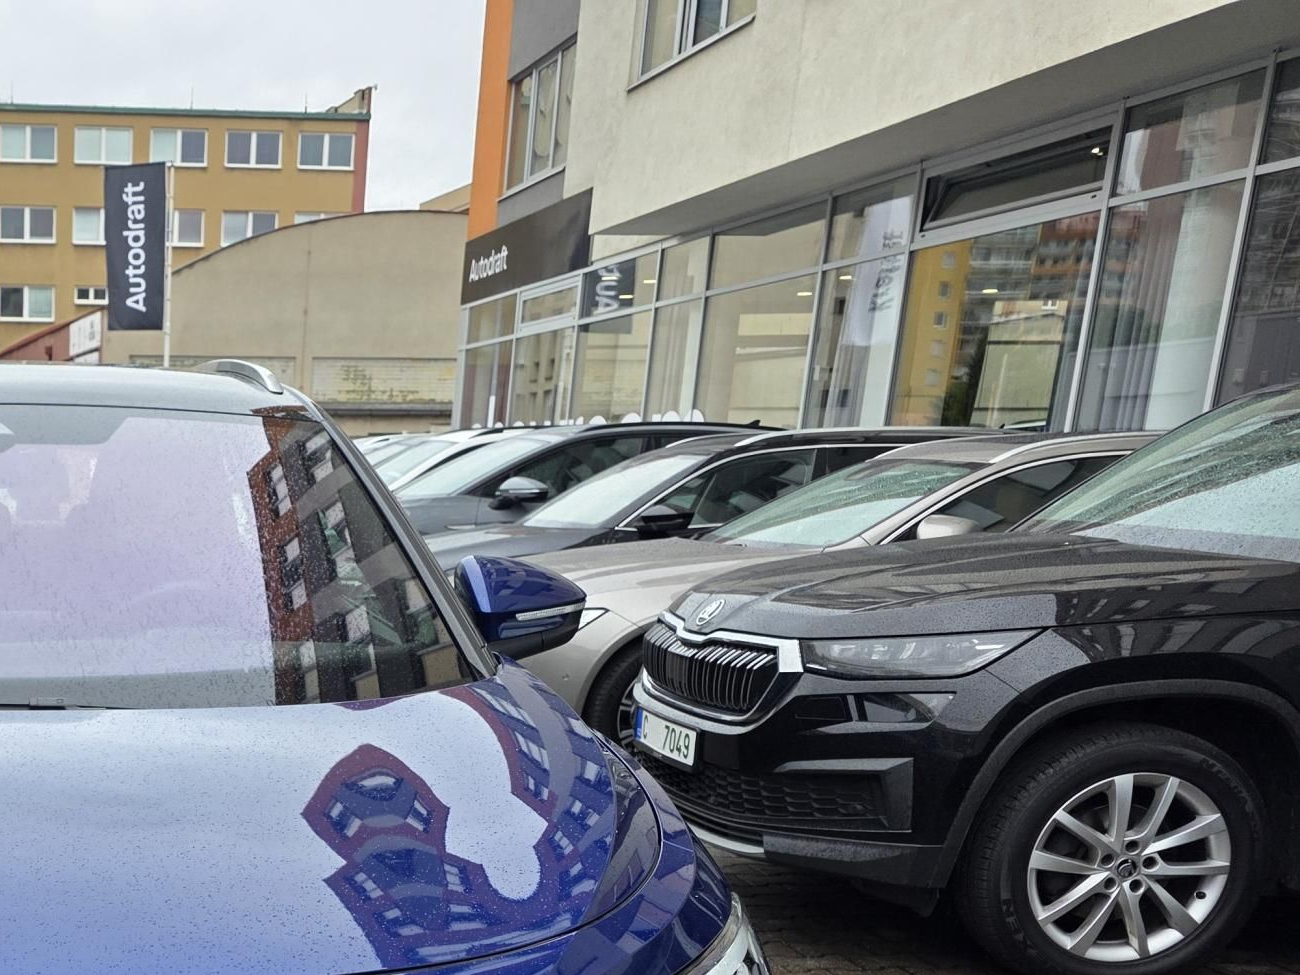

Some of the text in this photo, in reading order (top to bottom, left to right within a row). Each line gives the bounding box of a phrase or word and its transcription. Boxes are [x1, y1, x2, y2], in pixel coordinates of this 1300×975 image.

[122, 181, 147, 313] Autodraft
[469, 245, 509, 283] Autodraft
[663, 725, 691, 759] 7049
